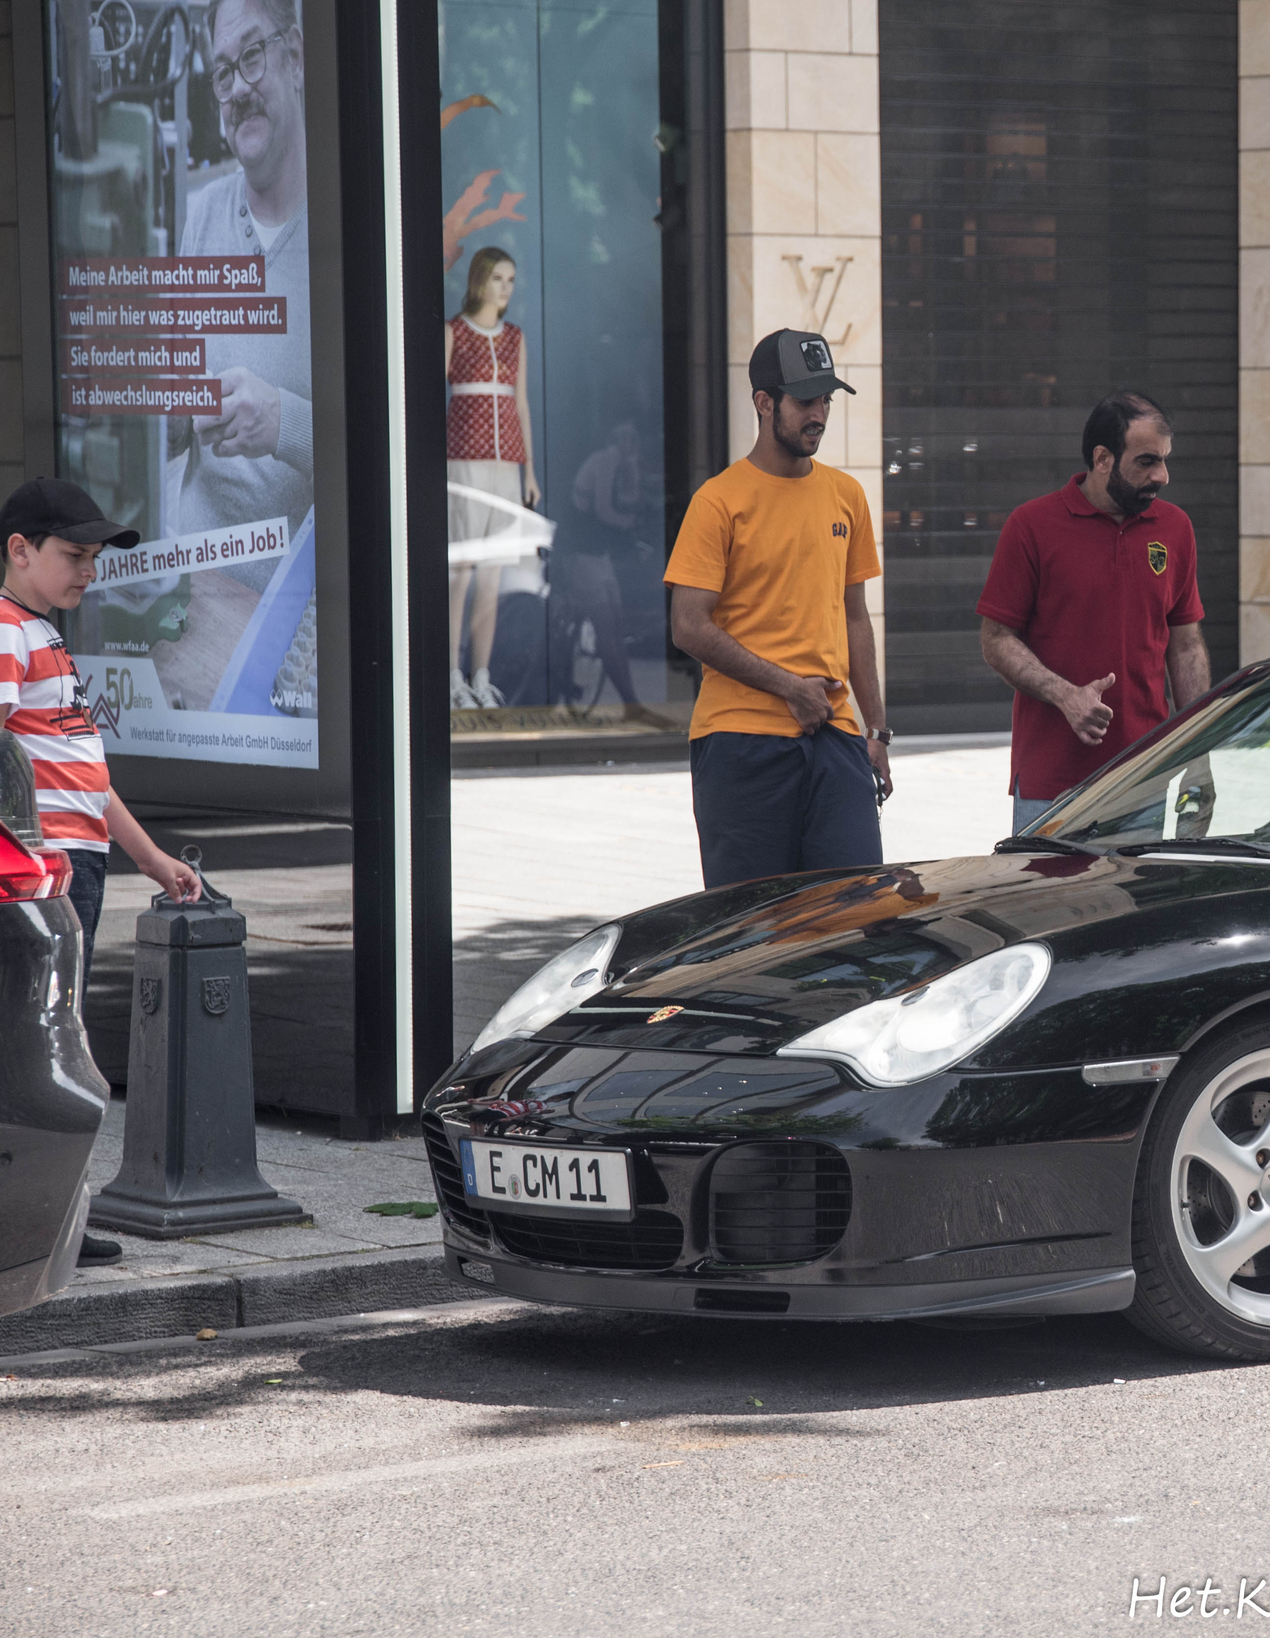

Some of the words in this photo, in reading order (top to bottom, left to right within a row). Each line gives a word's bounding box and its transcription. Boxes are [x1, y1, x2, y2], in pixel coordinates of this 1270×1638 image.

[69, 266, 105, 286] Meine
[108, 265, 149, 286] Arbeit
[151, 264, 194, 285] macht
[197, 263, 220, 285] mir
[223, 262, 262, 289] Spaß,
[70, 305, 93, 326] weil
[96, 305, 117, 326] mir
[120, 304, 146, 325] hier
[148, 309, 175, 325] was
[177, 306, 244, 330] zugetraut
[247, 303, 282, 325] wird.
[71, 346, 88, 366] Sie
[91, 345, 135, 366] fordert
[138, 345, 170, 366] mich
[173, 345, 200, 366] und
[72, 385, 87, 405] ist
[89, 384, 217, 411] abwechslungsreich.
[832, 522, 848, 539] GAP
[101, 551, 149, 582] JAHRE
[152, 544, 192, 571] mehr
[195, 538, 217, 563] als
[221, 534, 245, 559] ein
[104, 640, 149, 652] www.wfaa.de
[283, 690, 312, 708] Wall
[130, 726, 165, 742] Werkstatt
[166, 729, 176, 743] für
[178, 732, 219, 748] angepasste
[221, 733, 244, 748] Arbeit
[246, 735, 269, 750] GmbH
[270, 738, 312, 752] Düsseldorf
[489, 1150, 506, 1194] E
[522, 1153, 561, 1199] CM
[568, 1157, 607, 1203] 11
